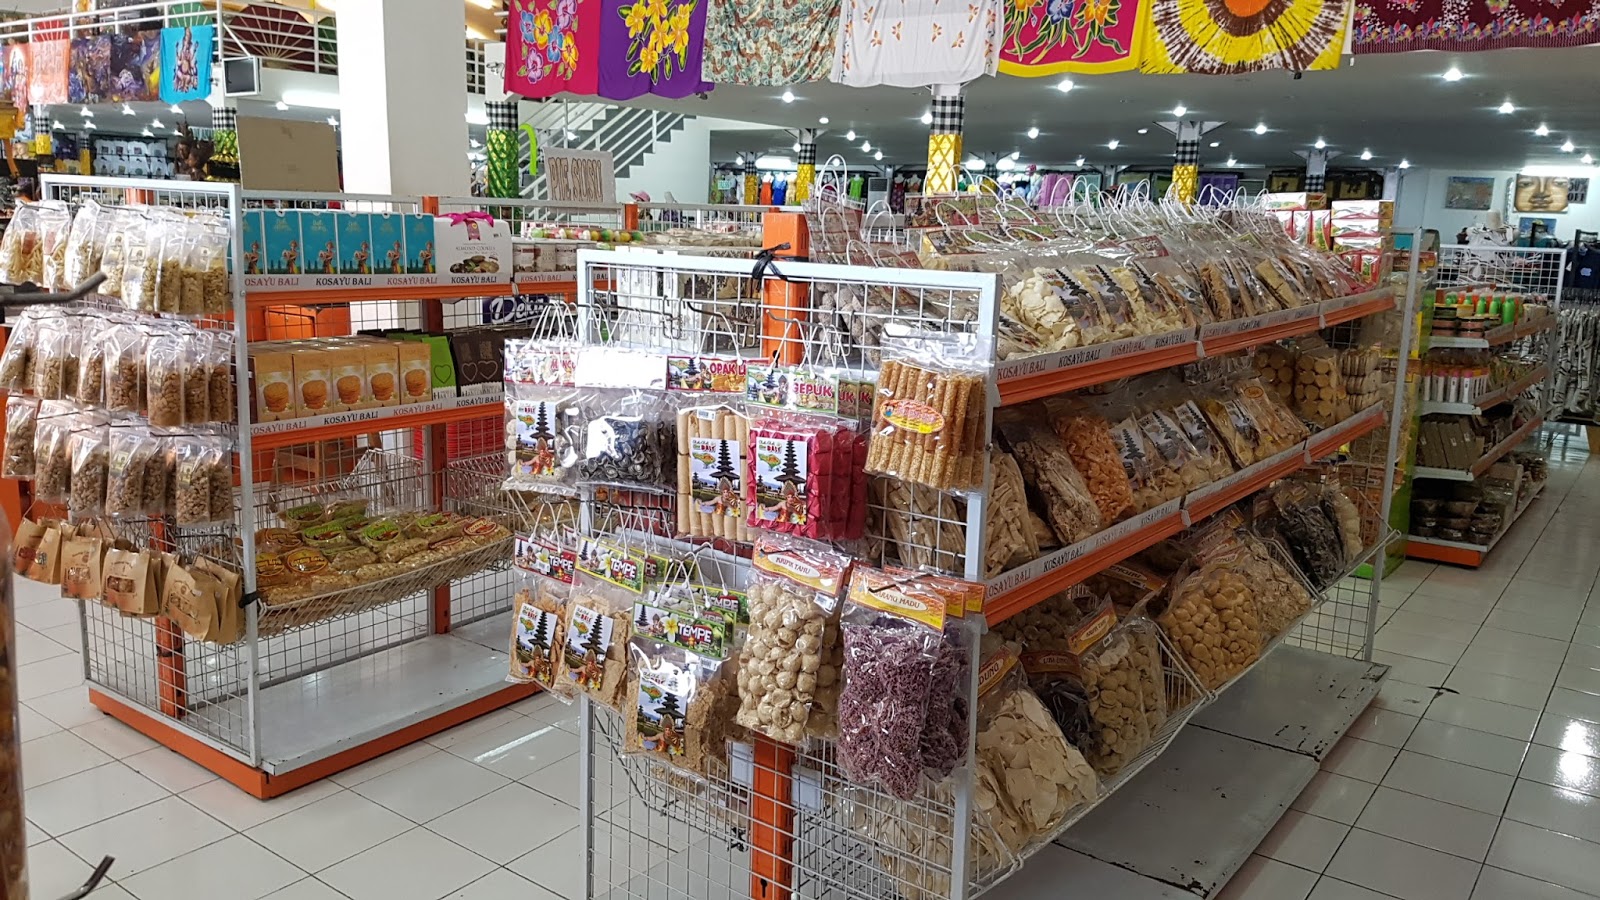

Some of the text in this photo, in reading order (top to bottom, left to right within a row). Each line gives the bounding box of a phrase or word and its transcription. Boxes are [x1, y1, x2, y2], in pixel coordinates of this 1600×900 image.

[572, 158, 603, 202] SUSU
[277, 277, 299, 286] BALI
[352, 277, 372, 285] BALI
[419, 276, 438, 285] BALI
[1086, 349, 1101, 360] BALI
[709, 362, 736, 375] OPAK
[1029, 359, 1047, 373] BALI
[484, 395, 501, 404] BALI
[425, 403, 443, 412] BALI
[359, 411, 379, 420] BALI
[285, 420, 307, 431] BALI
[1070, 544, 1086, 562] BALI
[610, 557, 637, 578] TEMPE
[1014, 568, 1032, 586] BALI
[875, 590, 921, 609] ARANG MADU
[678, 622, 712, 643] TEMPE
